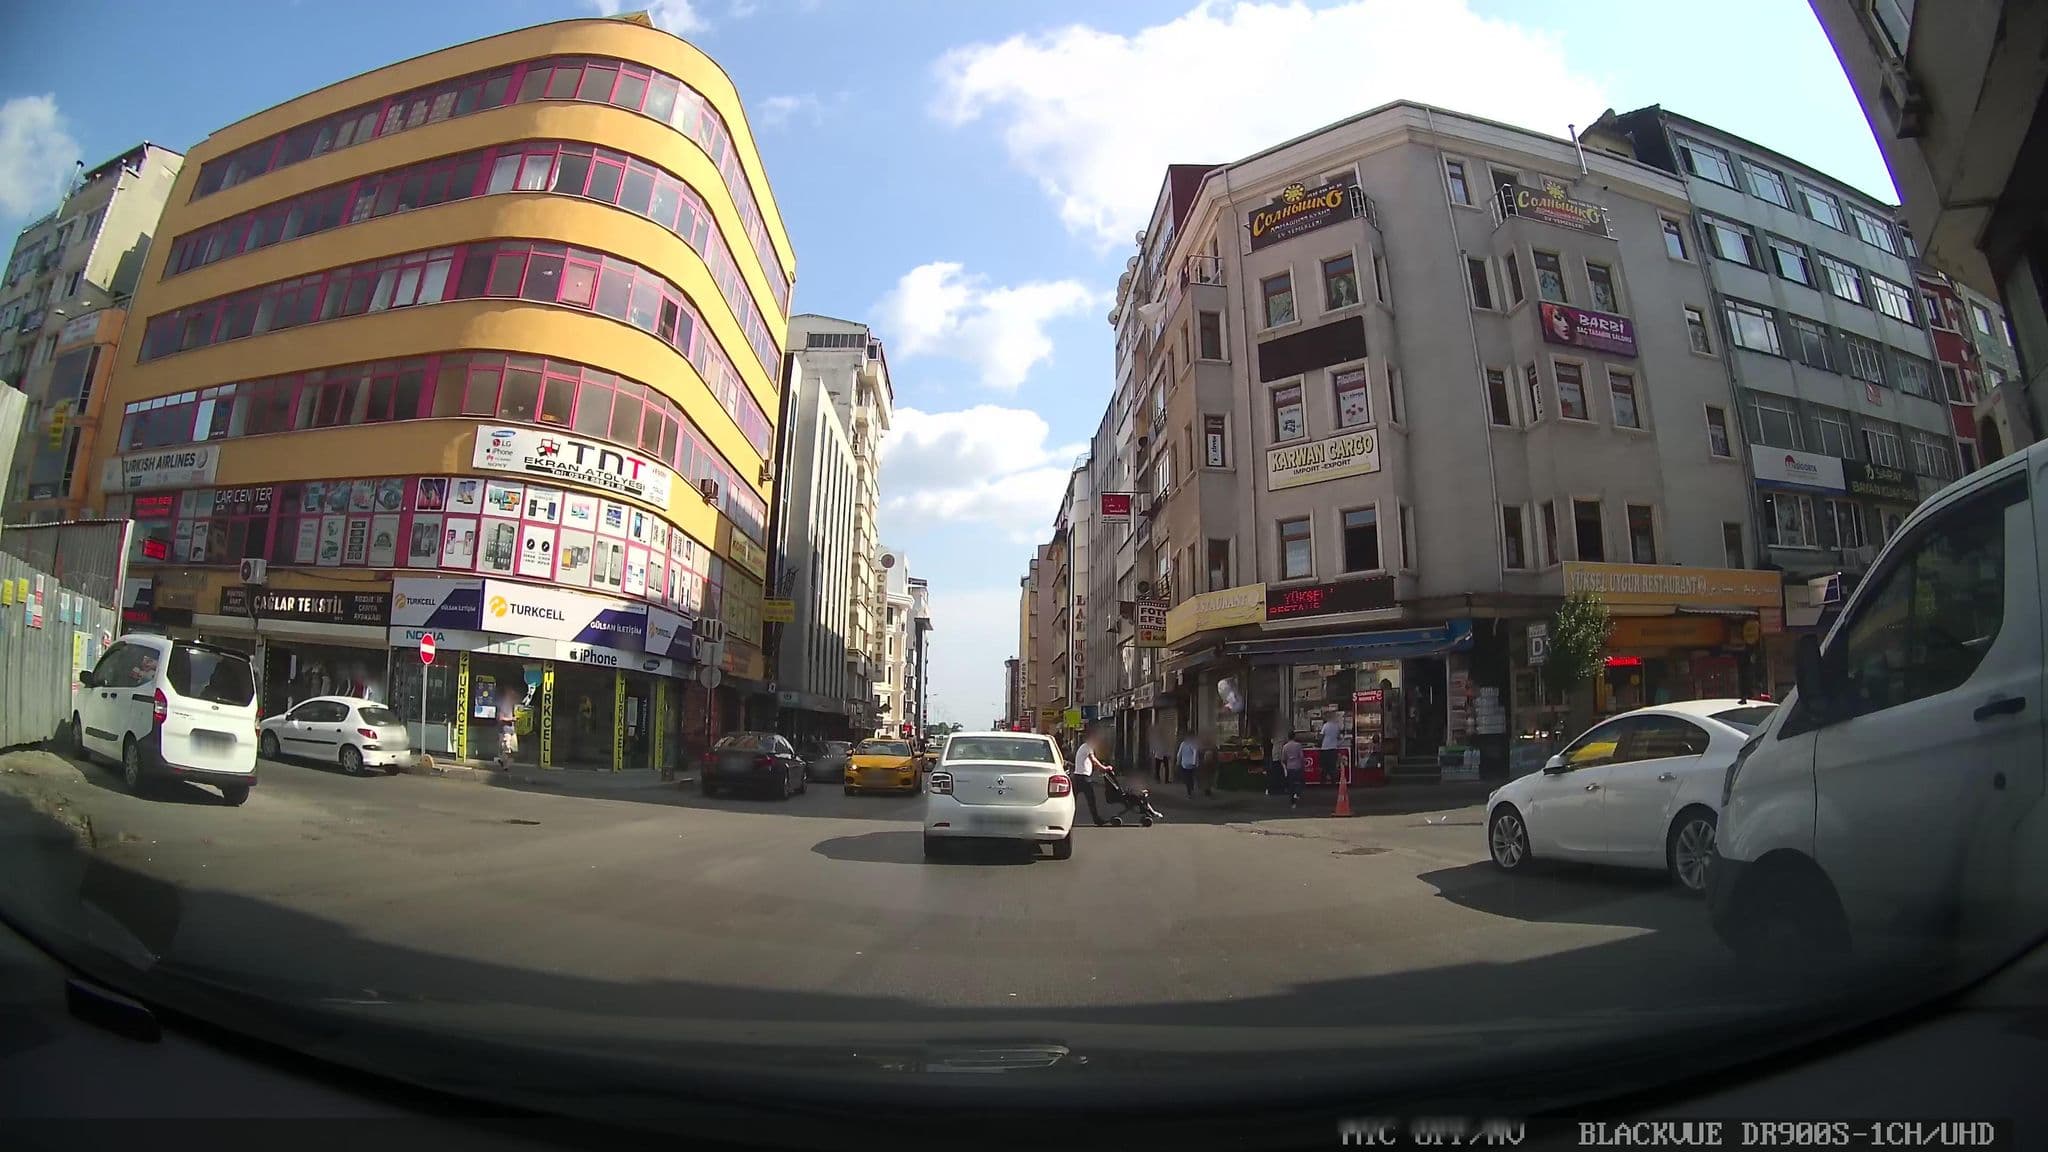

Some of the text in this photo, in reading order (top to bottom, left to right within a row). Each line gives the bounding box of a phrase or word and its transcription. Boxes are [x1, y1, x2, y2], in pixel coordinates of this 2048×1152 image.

[1272, 433, 1374, 472] KARWAN CARGO
[123, 452, 195, 474] TURKISH AIRLINES
[524, 456, 579, 472] EKRAN
[1293, 464, 1319, 475] IMPORT
[215, 489, 231, 503] CAR
[1642, 574, 1696, 594] RESTAURANT
[254, 592, 295, 616] ÇAĞLAR
[298, 595, 343, 614] TEKSTİL
[406, 597, 436, 606] TURKCELL
[510, 603, 565, 621] TURKCELL
[590, 620, 616, 632] GÜLSAN
[406, 629, 445, 642] NOIA
[580, 648, 617, 666] iPhone
[456, 663, 467, 759] TURKCELL
[543, 672, 554, 764] TURKCELL
[616, 679, 625, 771] TURKCELL
